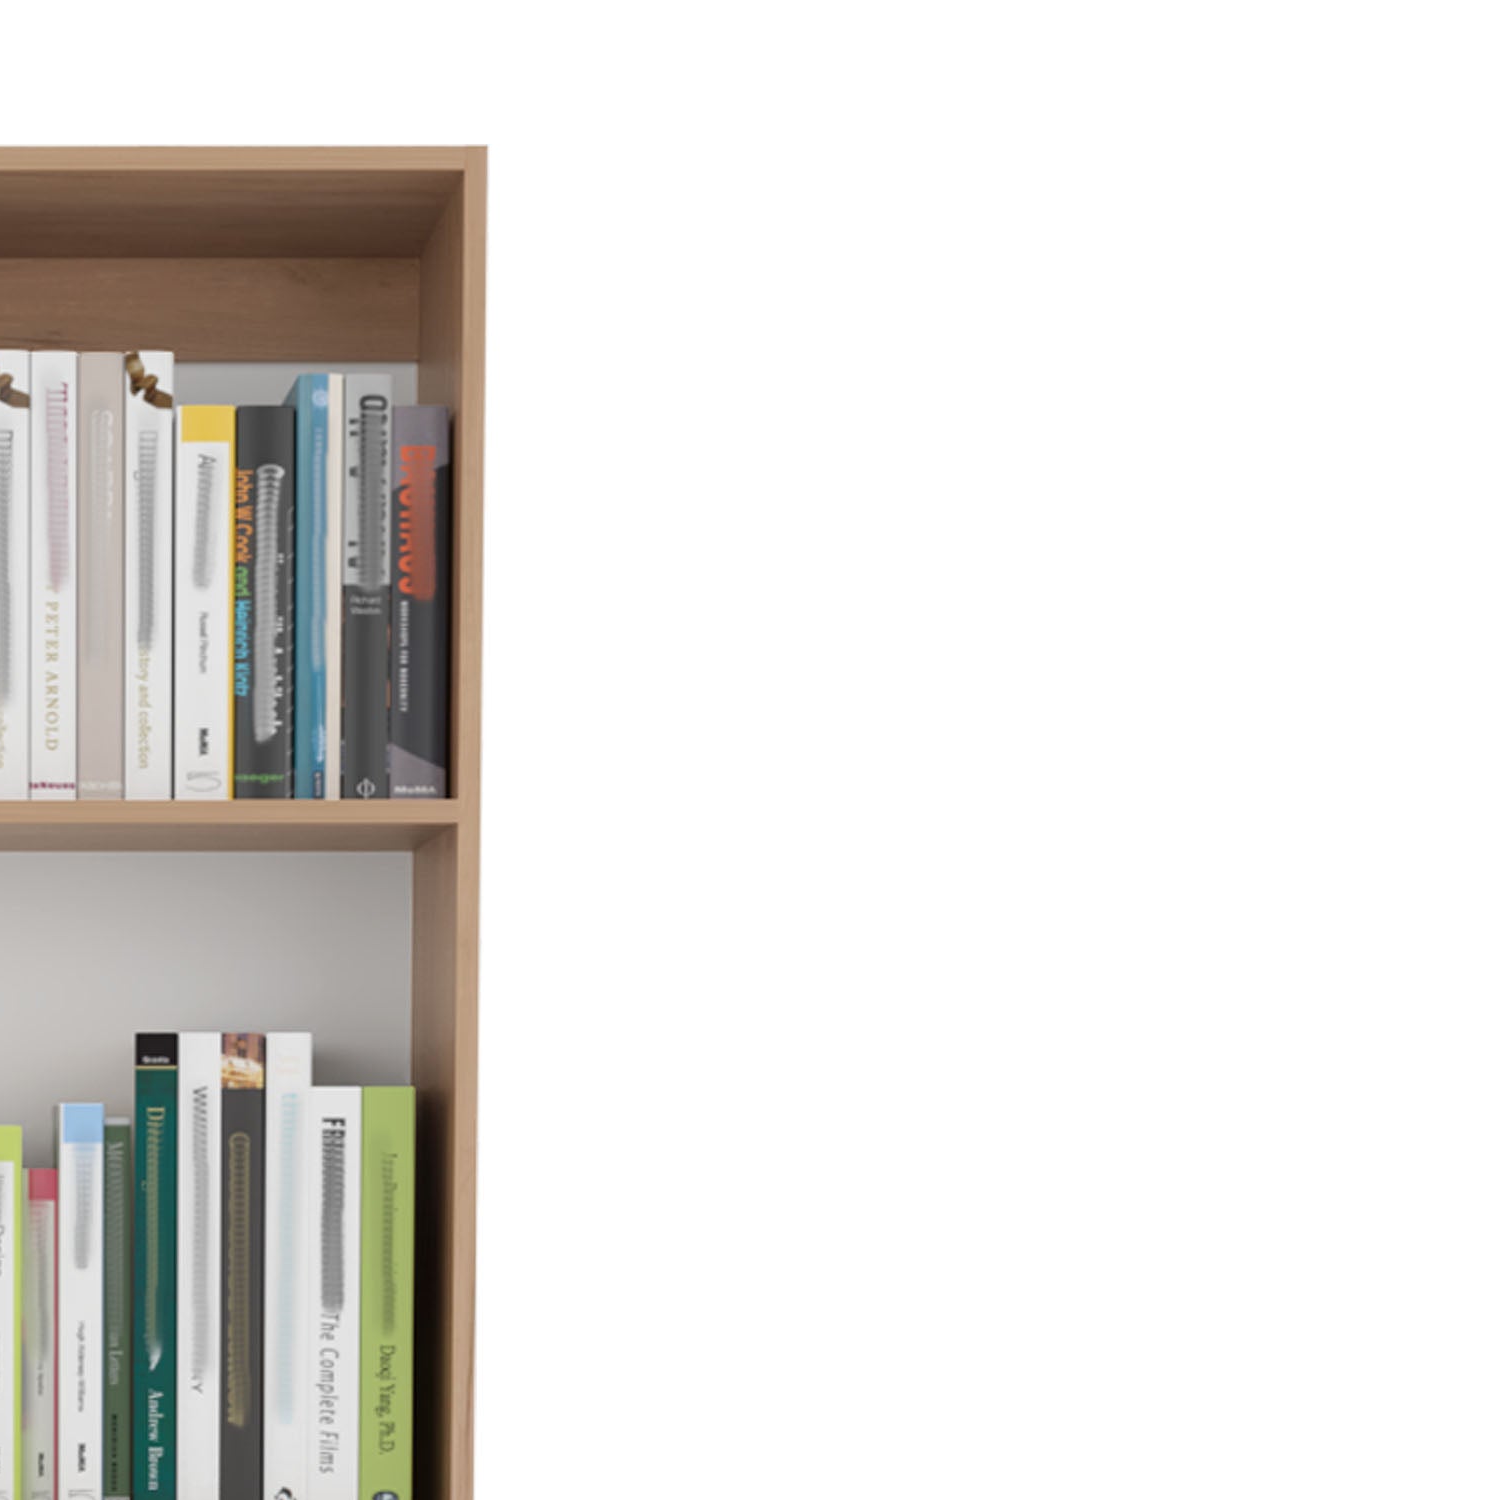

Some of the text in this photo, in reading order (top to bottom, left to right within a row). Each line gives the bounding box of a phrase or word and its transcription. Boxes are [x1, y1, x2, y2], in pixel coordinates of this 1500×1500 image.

[235, 469, 254, 504] John
[235, 523, 253, 563] Cook
[45, 601, 59, 752] PETER ARNOLD
[138, 684, 151, 708] and
[138, 711, 152, 769] collection
[320, 1313, 341, 1341] The
[376, 1344, 397, 1379] Daoqi
[316, 1348, 340, 1425] Complete
[375, 1383, 396, 1418] Yang,
[147, 1388, 165, 1442] Andrew
[147, 1446, 165, 1491] Brown
[318, 1430, 340, 1475] Films
